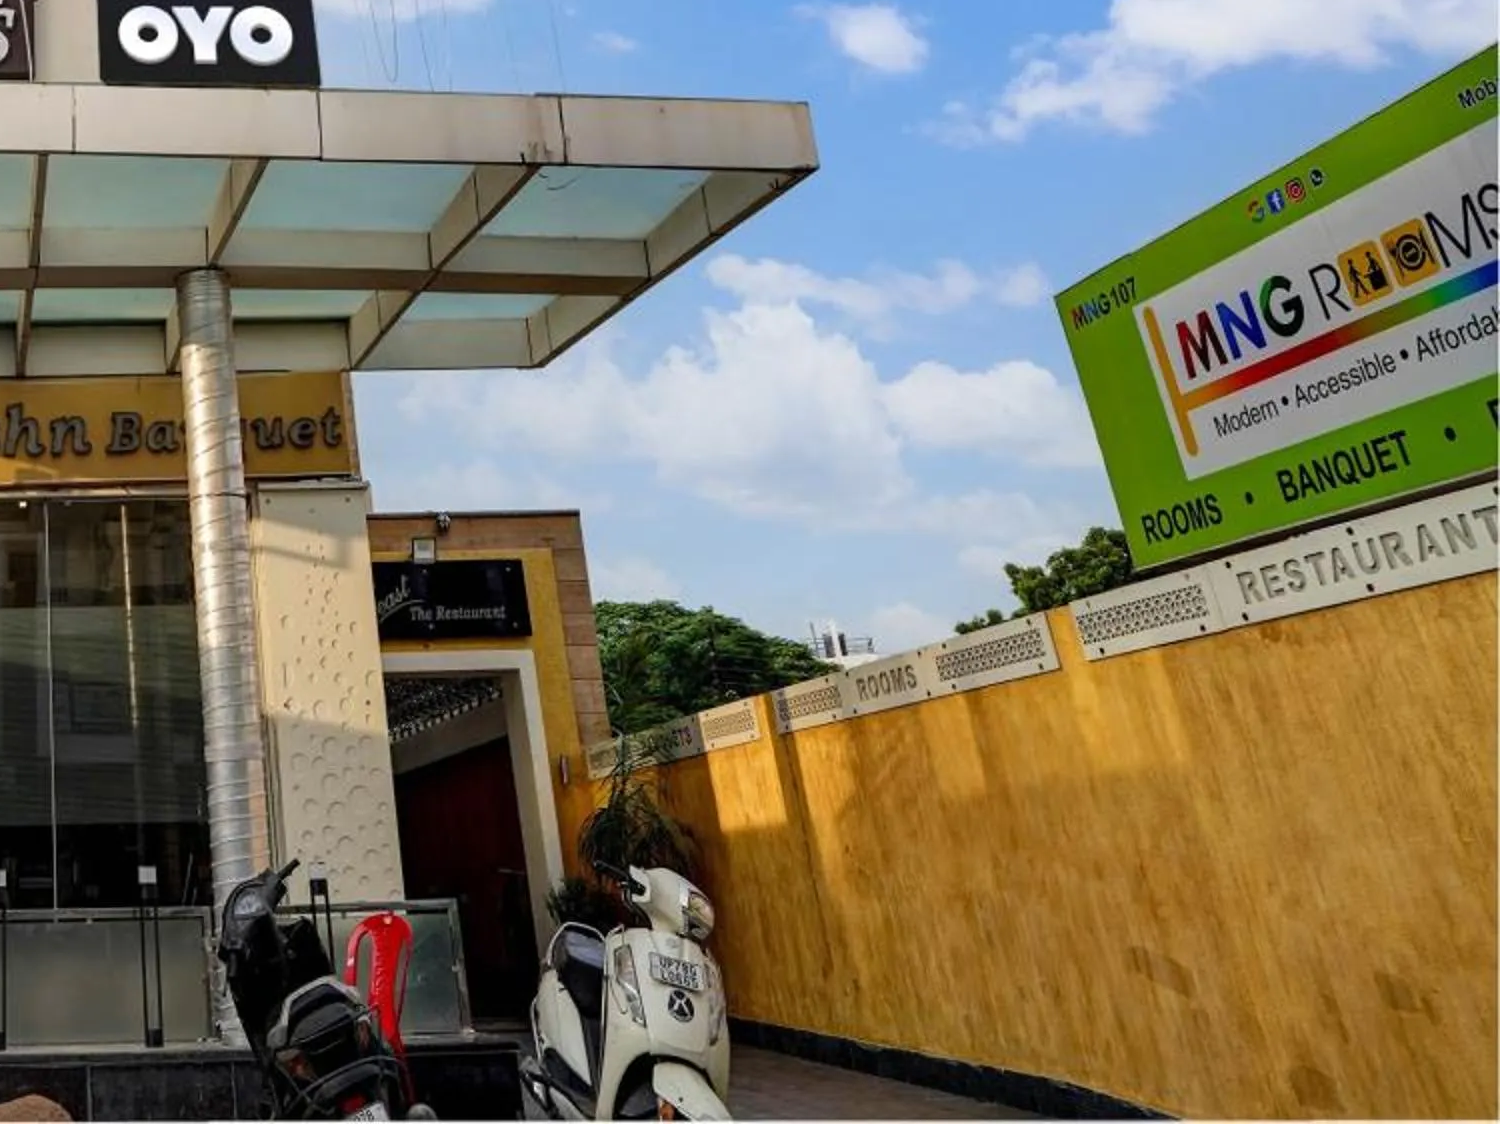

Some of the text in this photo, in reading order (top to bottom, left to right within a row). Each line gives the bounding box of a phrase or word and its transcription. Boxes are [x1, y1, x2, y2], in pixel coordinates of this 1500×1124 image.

[118, 5, 293, 64] OYO
[1176, 276, 1305, 380] MNG
[1213, 399, 1280, 437] Modern
[1295, 353, 1397, 408] Accessible
[106, 406, 341, 454] Bauet
[1141, 430, 1411, 546] ROOMS BANQUET
[410, 605, 506, 621] The Restaurant
[856, 664, 917, 701] ROOMS
